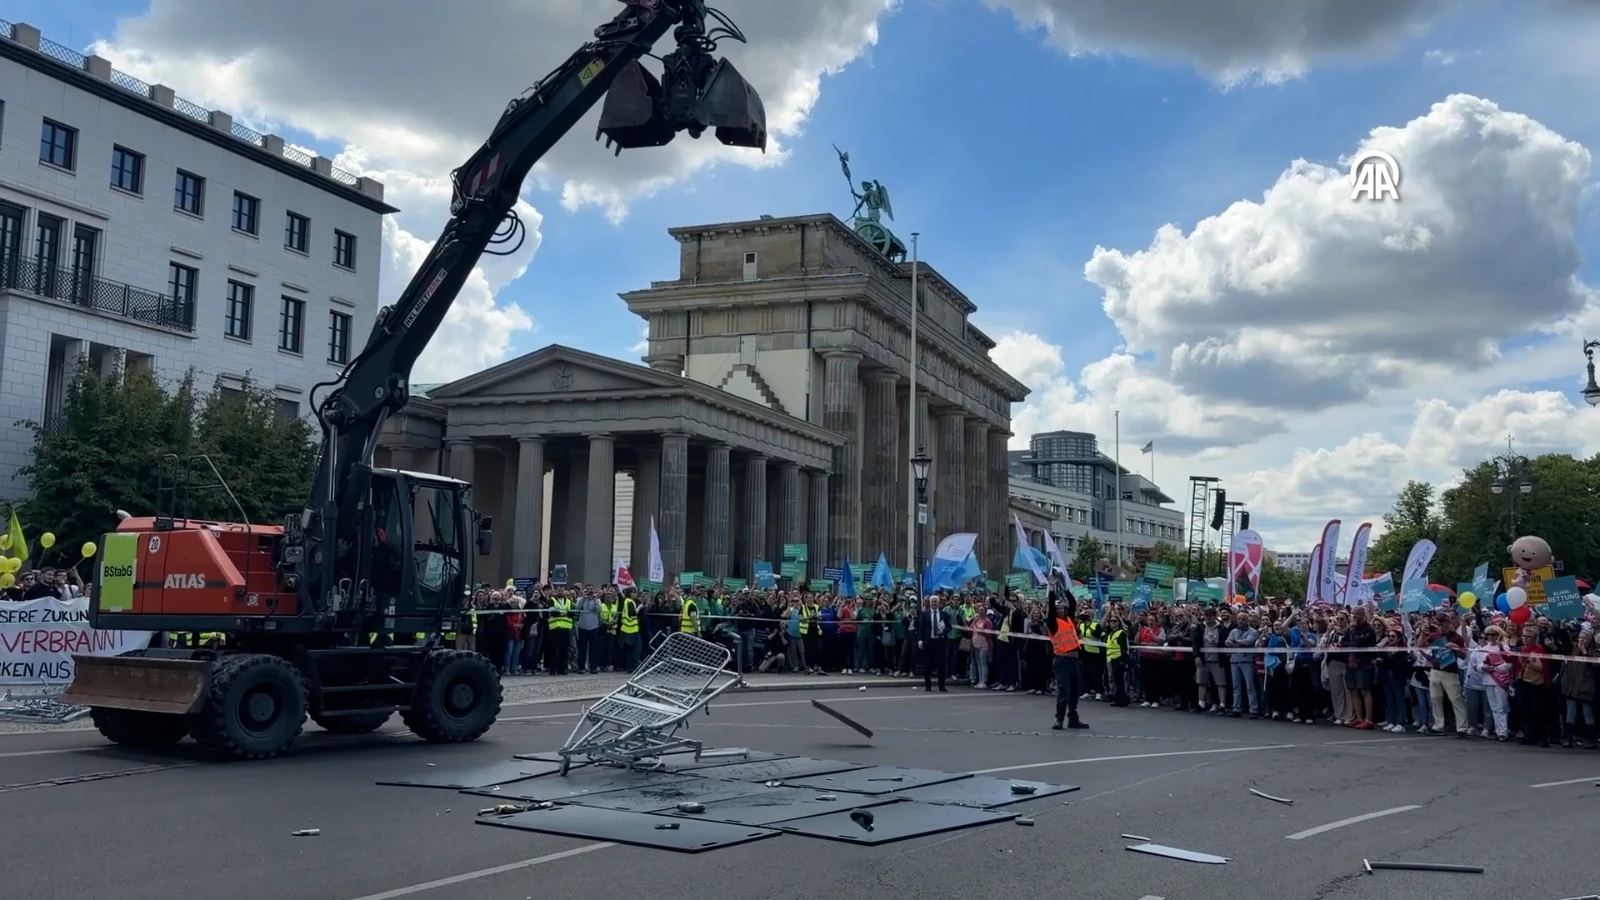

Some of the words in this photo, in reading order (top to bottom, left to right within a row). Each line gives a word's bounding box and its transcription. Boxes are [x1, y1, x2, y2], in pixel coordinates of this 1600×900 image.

[150, 538, 159, 551] 20
[104, 565, 133, 577] BStabG
[163, 573, 206, 589] ATLAS
[1547, 593, 1580, 603] RETTUNG
[37, 660, 71, 679] AUS
